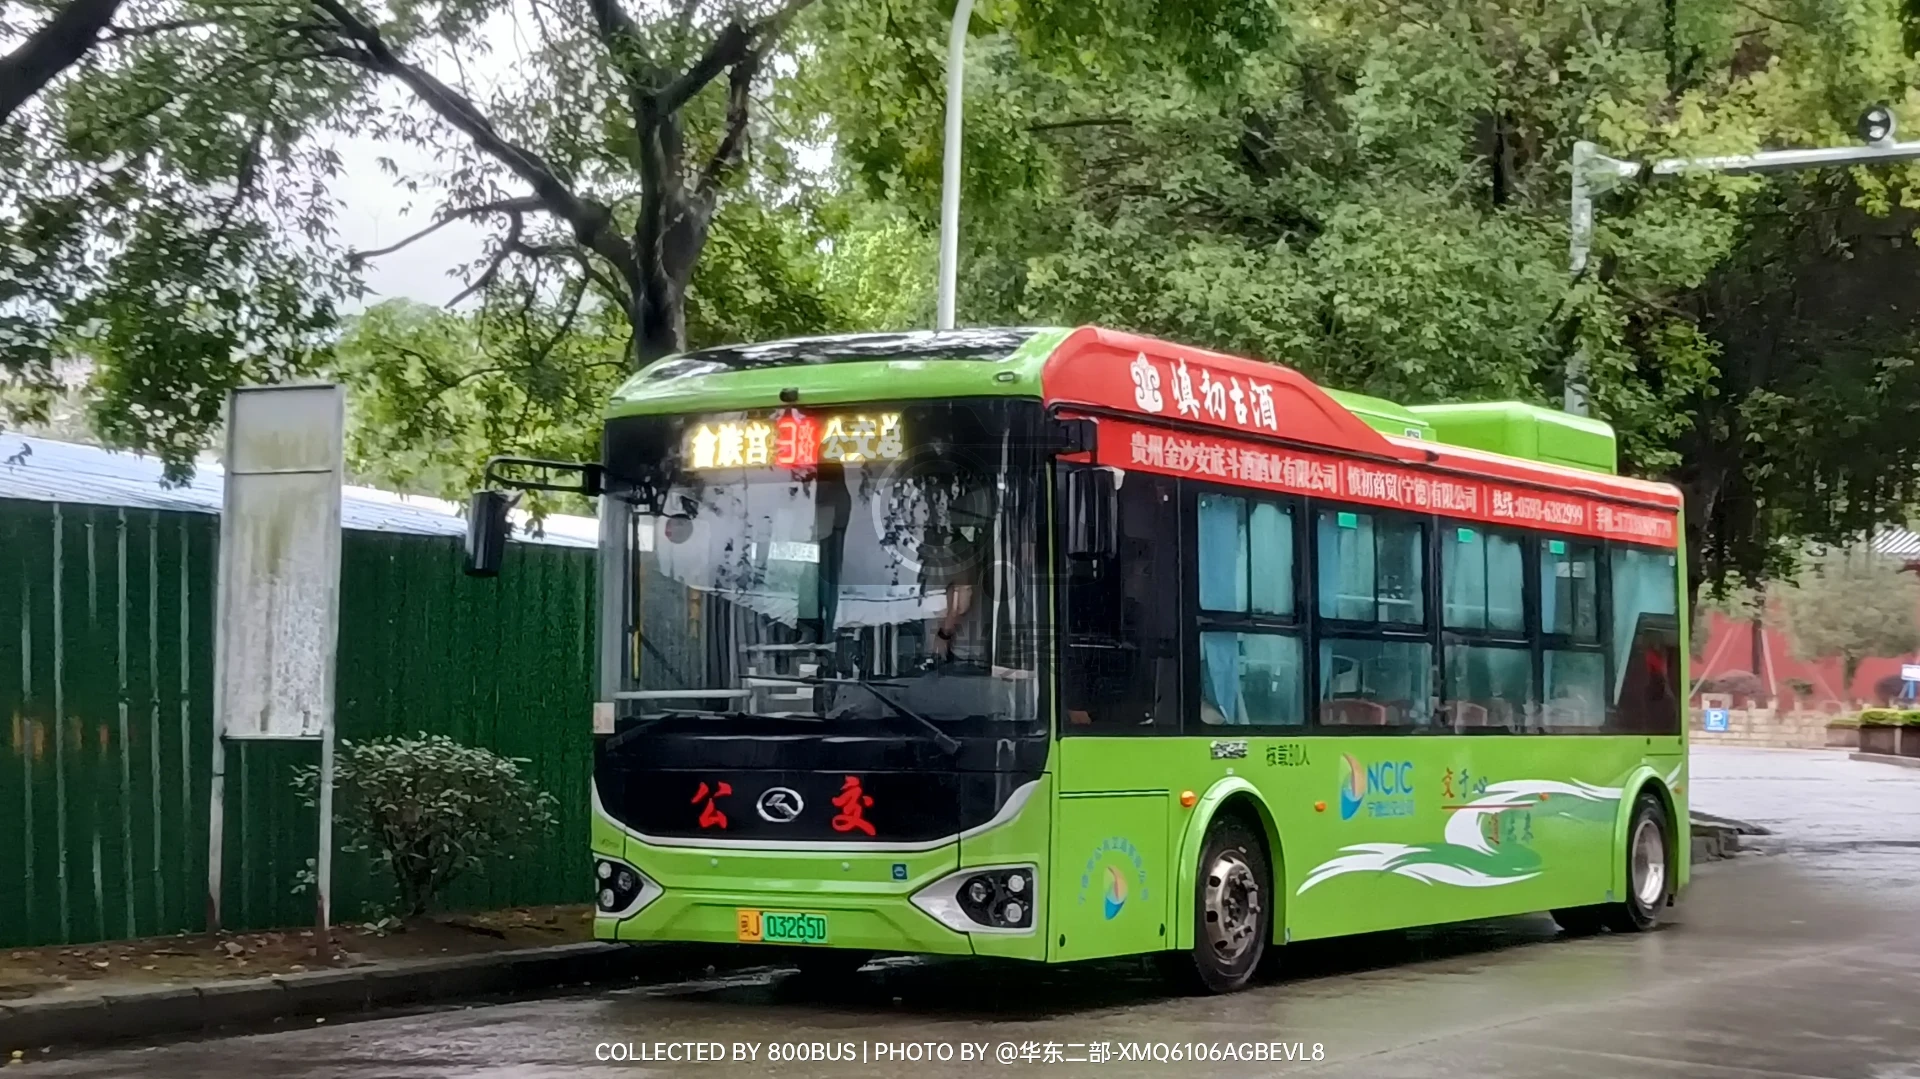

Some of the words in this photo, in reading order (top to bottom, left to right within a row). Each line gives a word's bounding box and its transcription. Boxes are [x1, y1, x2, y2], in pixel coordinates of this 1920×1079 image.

[1171, 357, 1278, 431] 慎初古酒
[1367, 761, 1413, 794] NCIC
[692, 781, 732, 829] 公
[832, 775, 876, 836] 交
